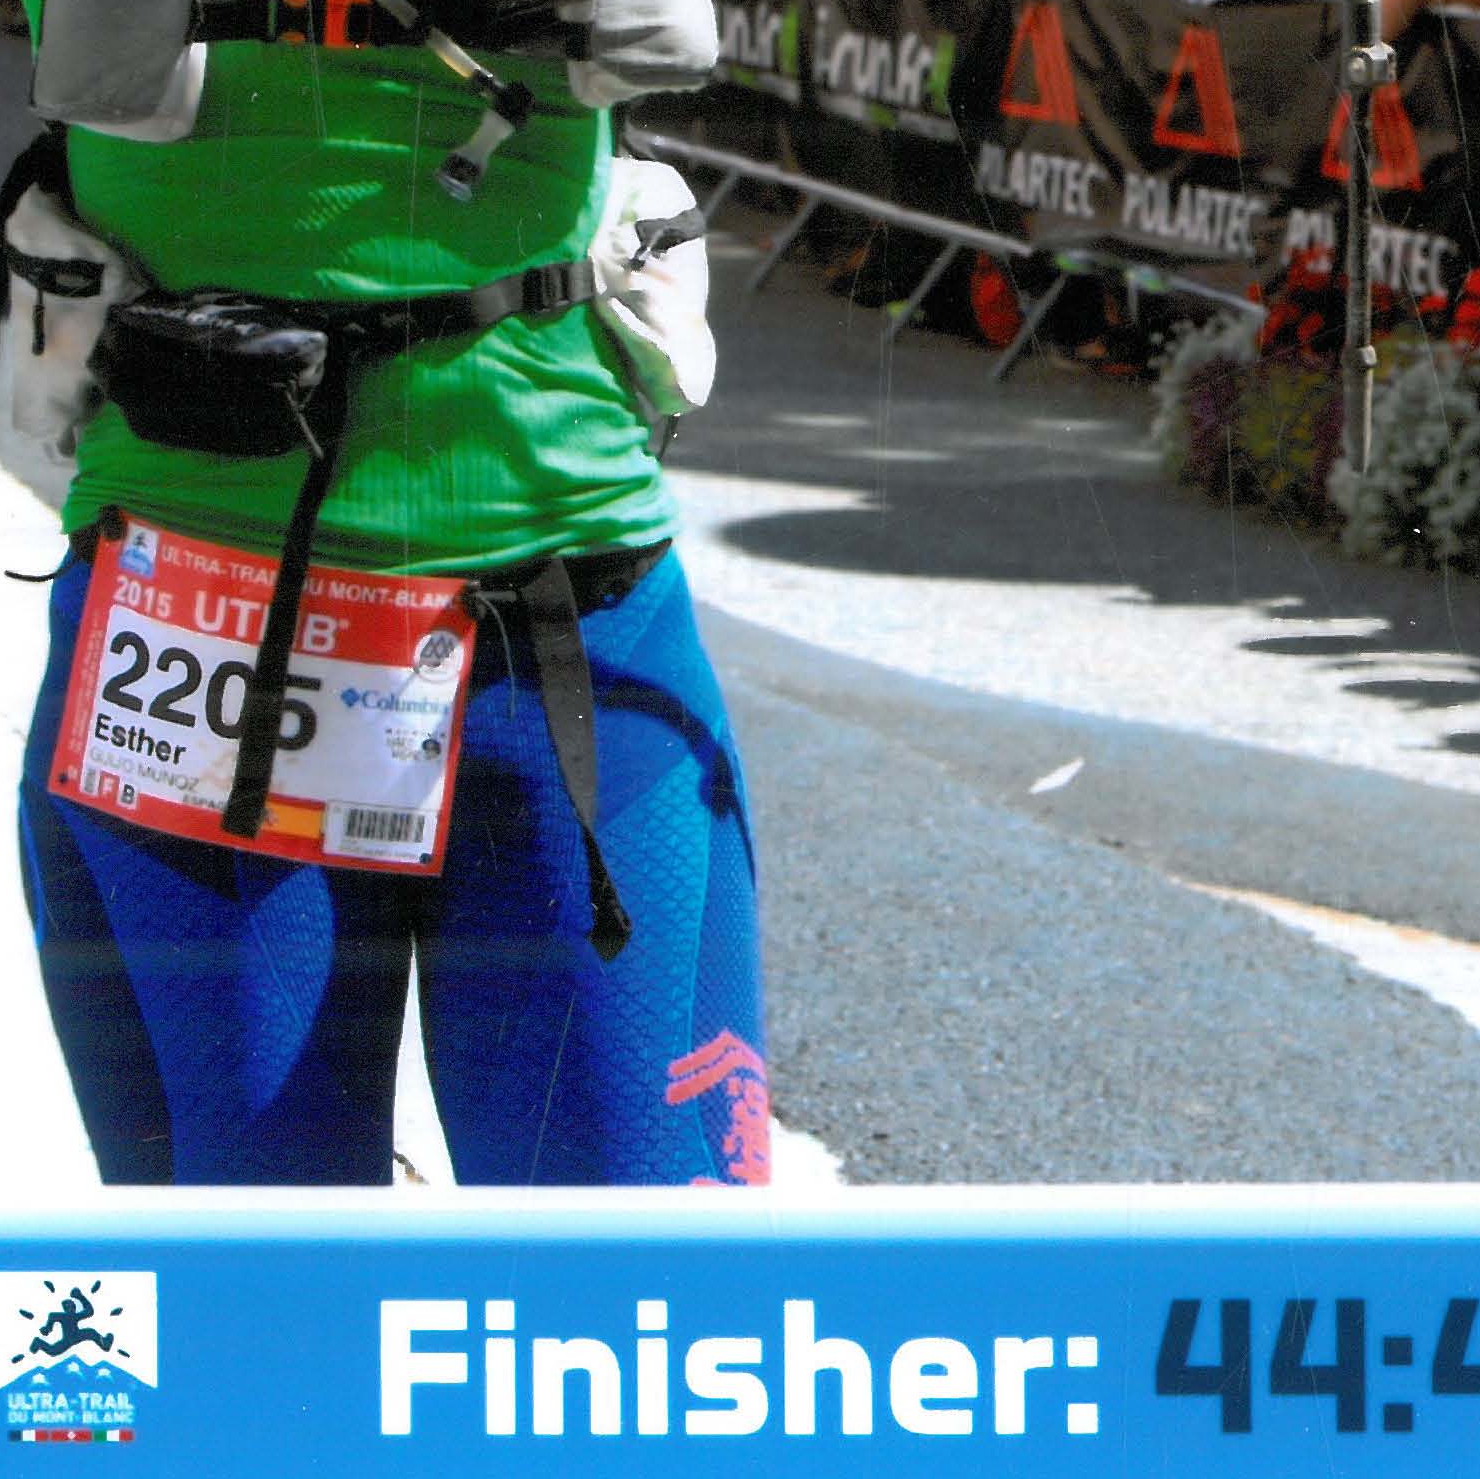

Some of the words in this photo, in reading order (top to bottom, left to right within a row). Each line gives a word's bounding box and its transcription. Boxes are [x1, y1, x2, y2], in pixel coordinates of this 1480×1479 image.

[1121, 172, 1269, 258] POLARTEC
[114, 575, 174, 619] 2015
[102, 630, 324, 752] 2205
[361, 689, 450, 714] Columbia
[94, 712, 187, 765] Esther
